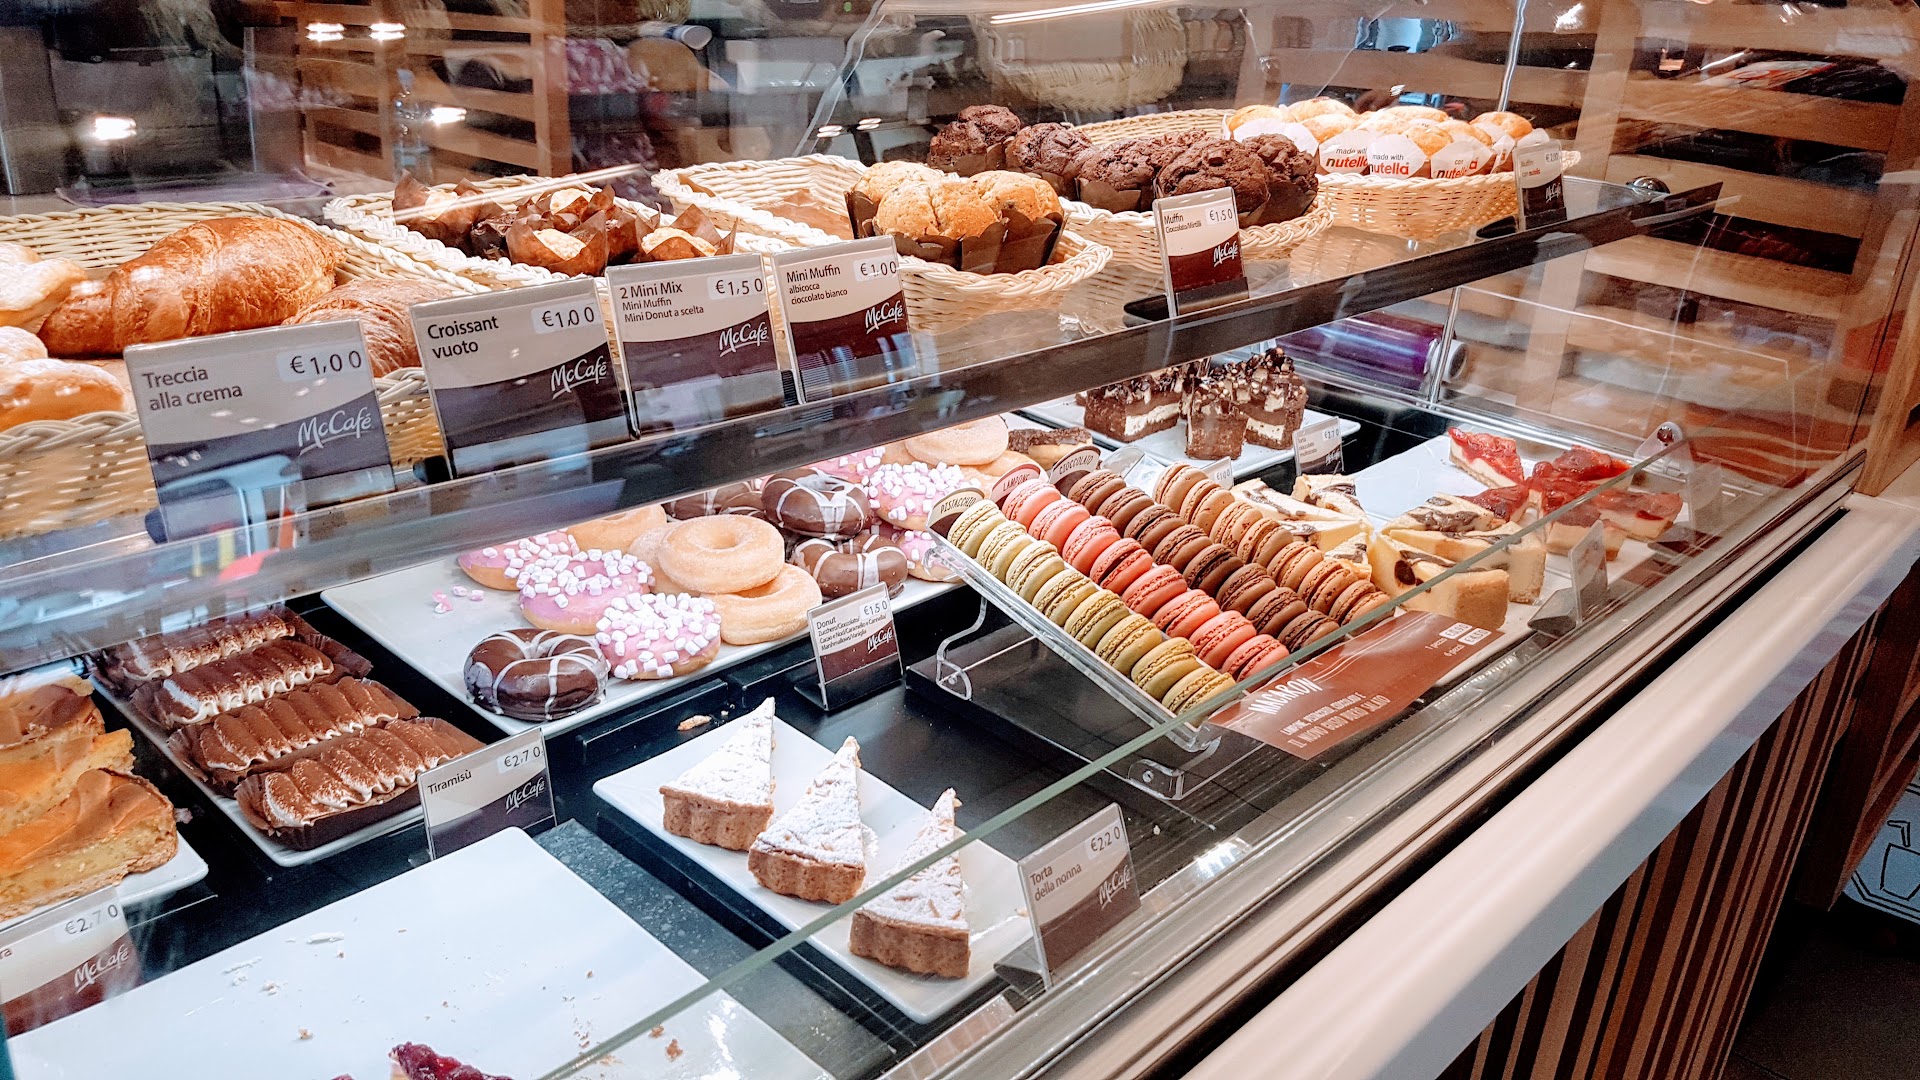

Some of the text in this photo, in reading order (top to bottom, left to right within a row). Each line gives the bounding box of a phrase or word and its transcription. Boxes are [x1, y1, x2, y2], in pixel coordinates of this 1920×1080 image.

[1164, 213, 1184, 225] Muffin
[1213, 241, 1238, 266] McCafé
[786, 264, 841, 283] Mini Muffin
[620, 281, 683, 299] 2 Mini Mix
[789, 283, 820, 294] albicocca
[791, 288, 848, 305] cioccolato bianco
[622, 297, 672, 311] Mini Muffin
[624, 312, 644, 323] Mini
[645, 309, 672, 320] Donut
[681, 305, 704, 316] scelta
[865, 300, 904, 332] McCafé
[427, 315, 499, 340] Croissant
[719, 321, 769, 354] McCafé
[432, 341, 478, 359] vuoto
[142, 366, 209, 389] Treccia
[550, 355, 607, 396] McCafé
[150, 384, 243, 411] alla crema
[297, 406, 372, 452] McCafé
[1058, 454, 1094, 475] CIOCCOLATO
[816, 616, 836, 630] Donut
[867, 626, 893, 652] McCafé
[1248, 677, 1323, 715] MACARON
[427, 769, 472, 795] Tiramisù
[505, 777, 545, 812] McCafé
[1030, 866, 1053, 886] Torta
[1035, 864, 1082, 901] della nonna
[1098, 864, 1131, 906] McCafé
[74, 943, 129, 990] McCafé
